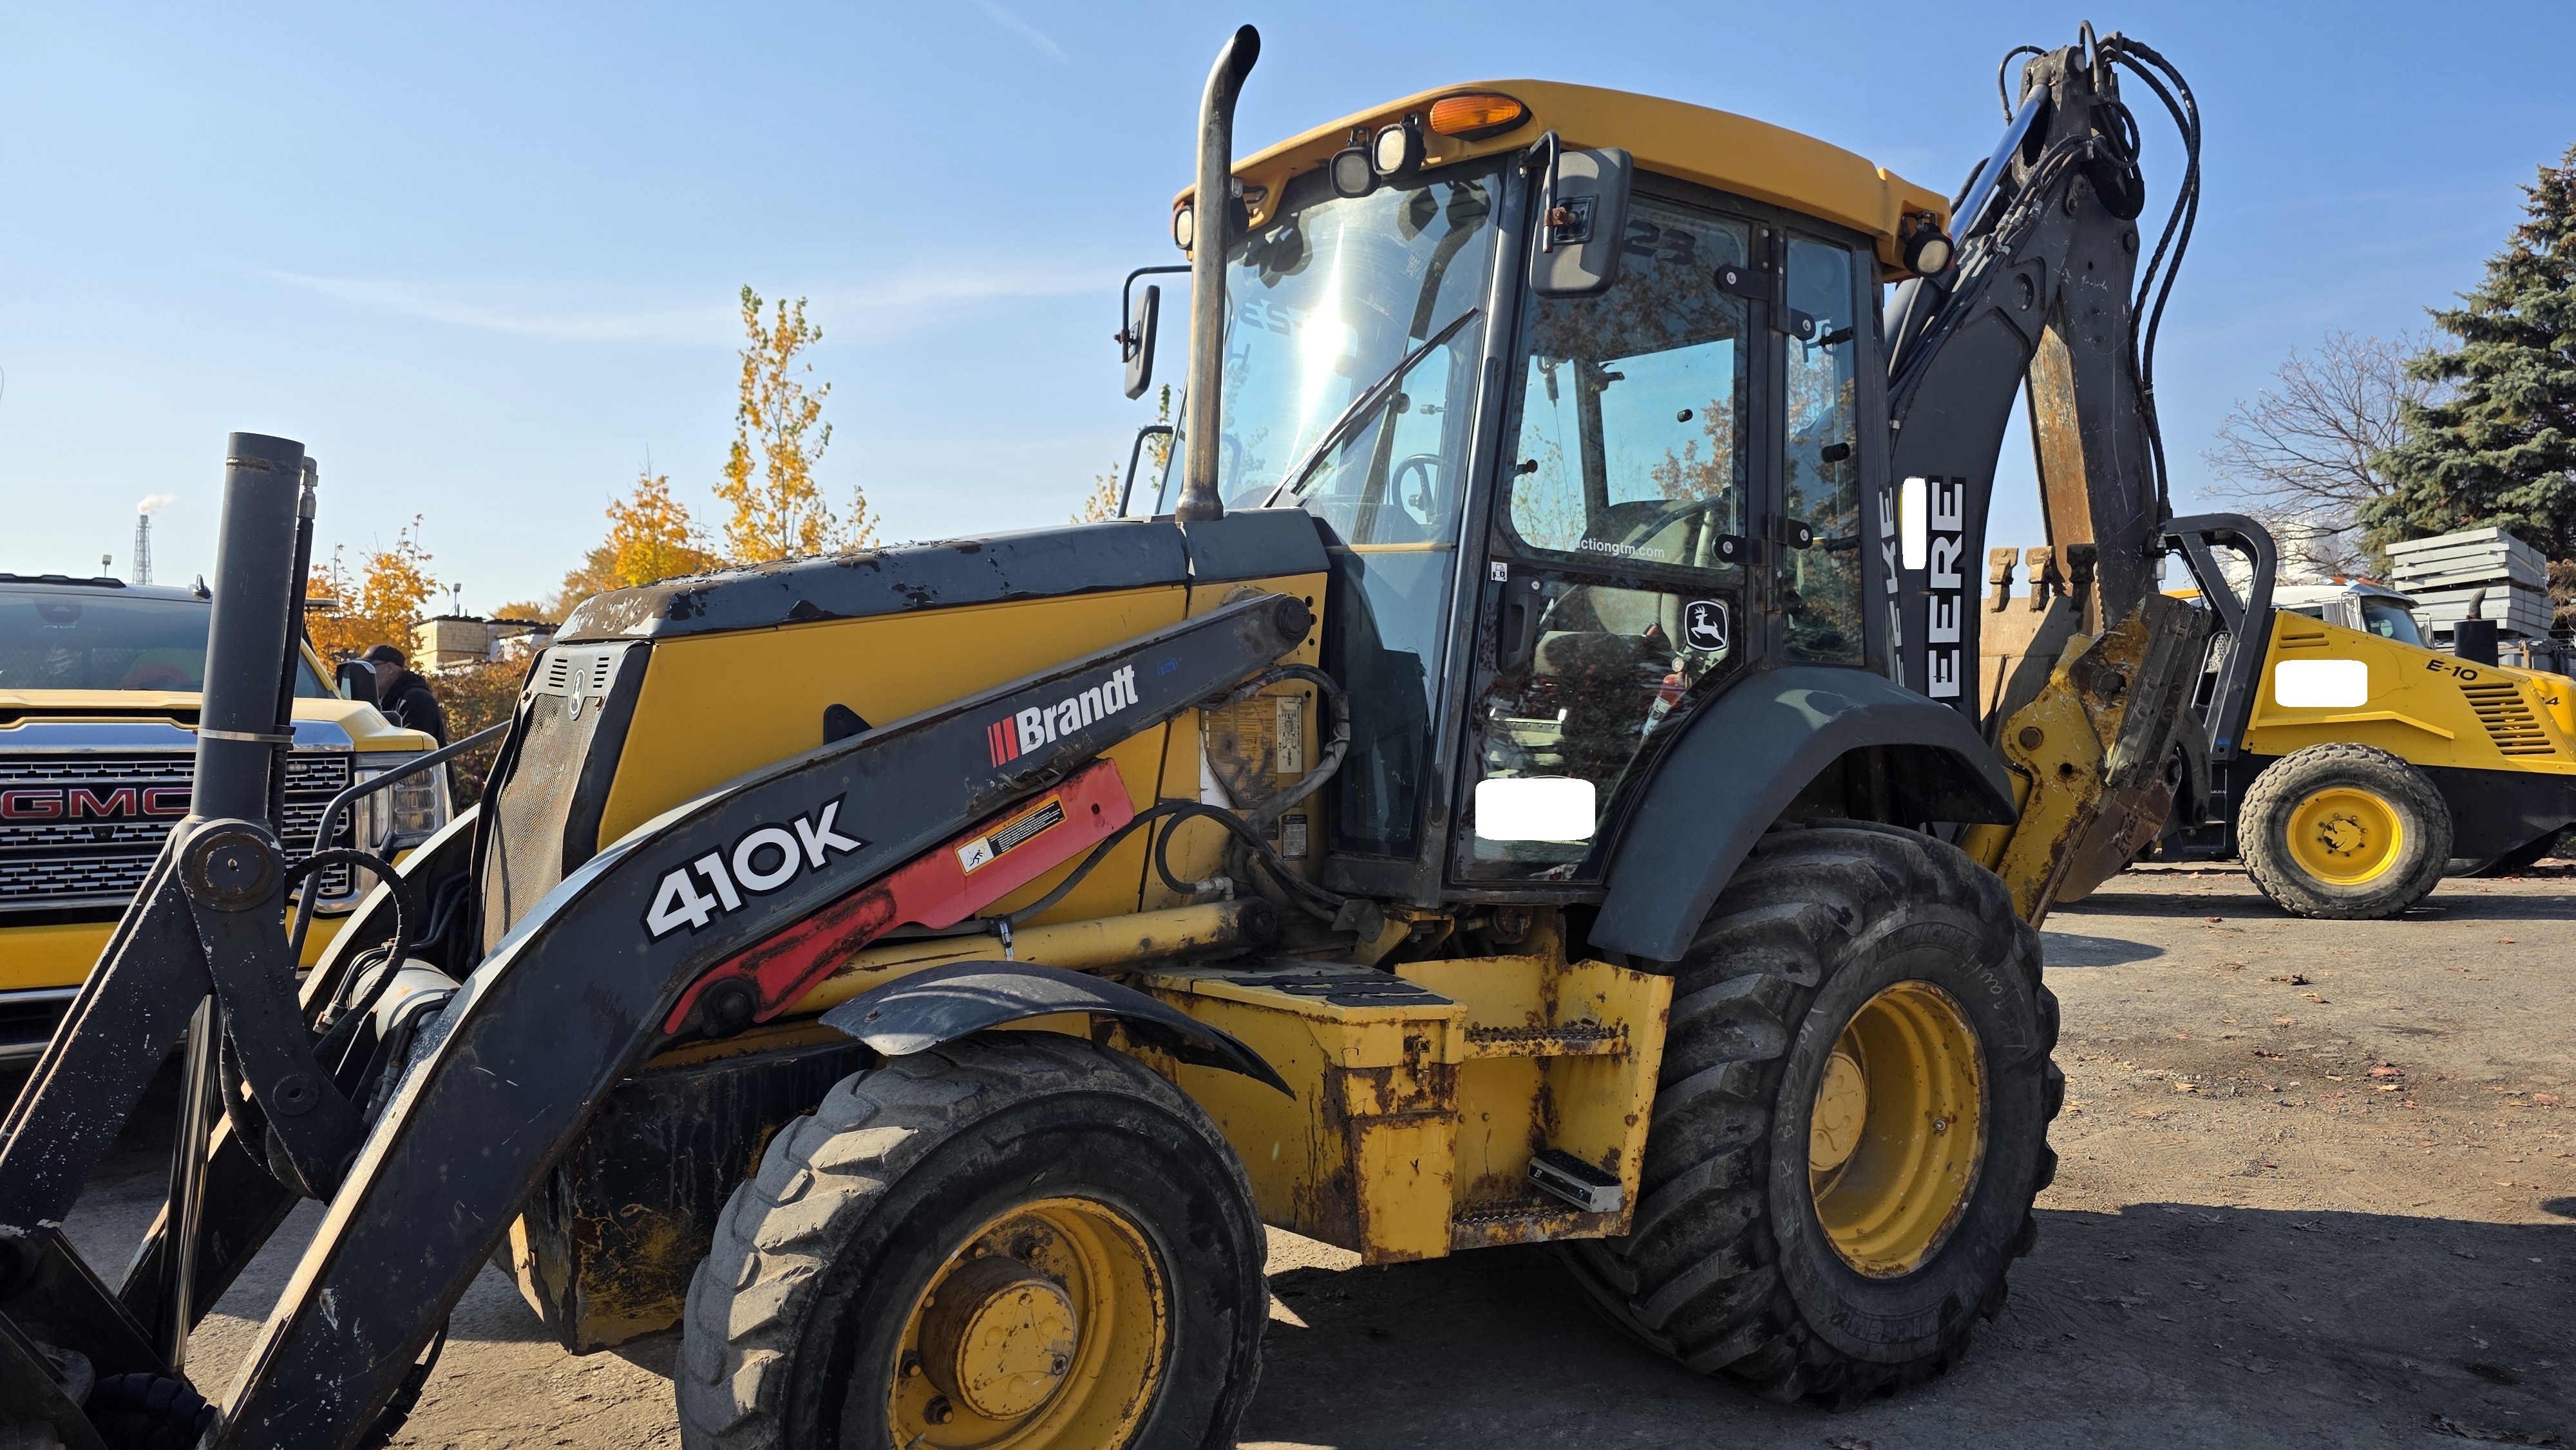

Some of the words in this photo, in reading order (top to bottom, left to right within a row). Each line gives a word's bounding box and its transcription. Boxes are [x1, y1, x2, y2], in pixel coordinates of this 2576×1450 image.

[1929, 482, 1963, 709] EERE
[2426, 659, 2478, 681] E-10
[1016, 664, 1139, 755] Brandt
[2541, 696, 2561, 706] 4
[1, 787, 193, 819] GMC
[1007, 805, 1041, 825] AVERTISSEMENT
[646, 800, 862, 937] 410K
